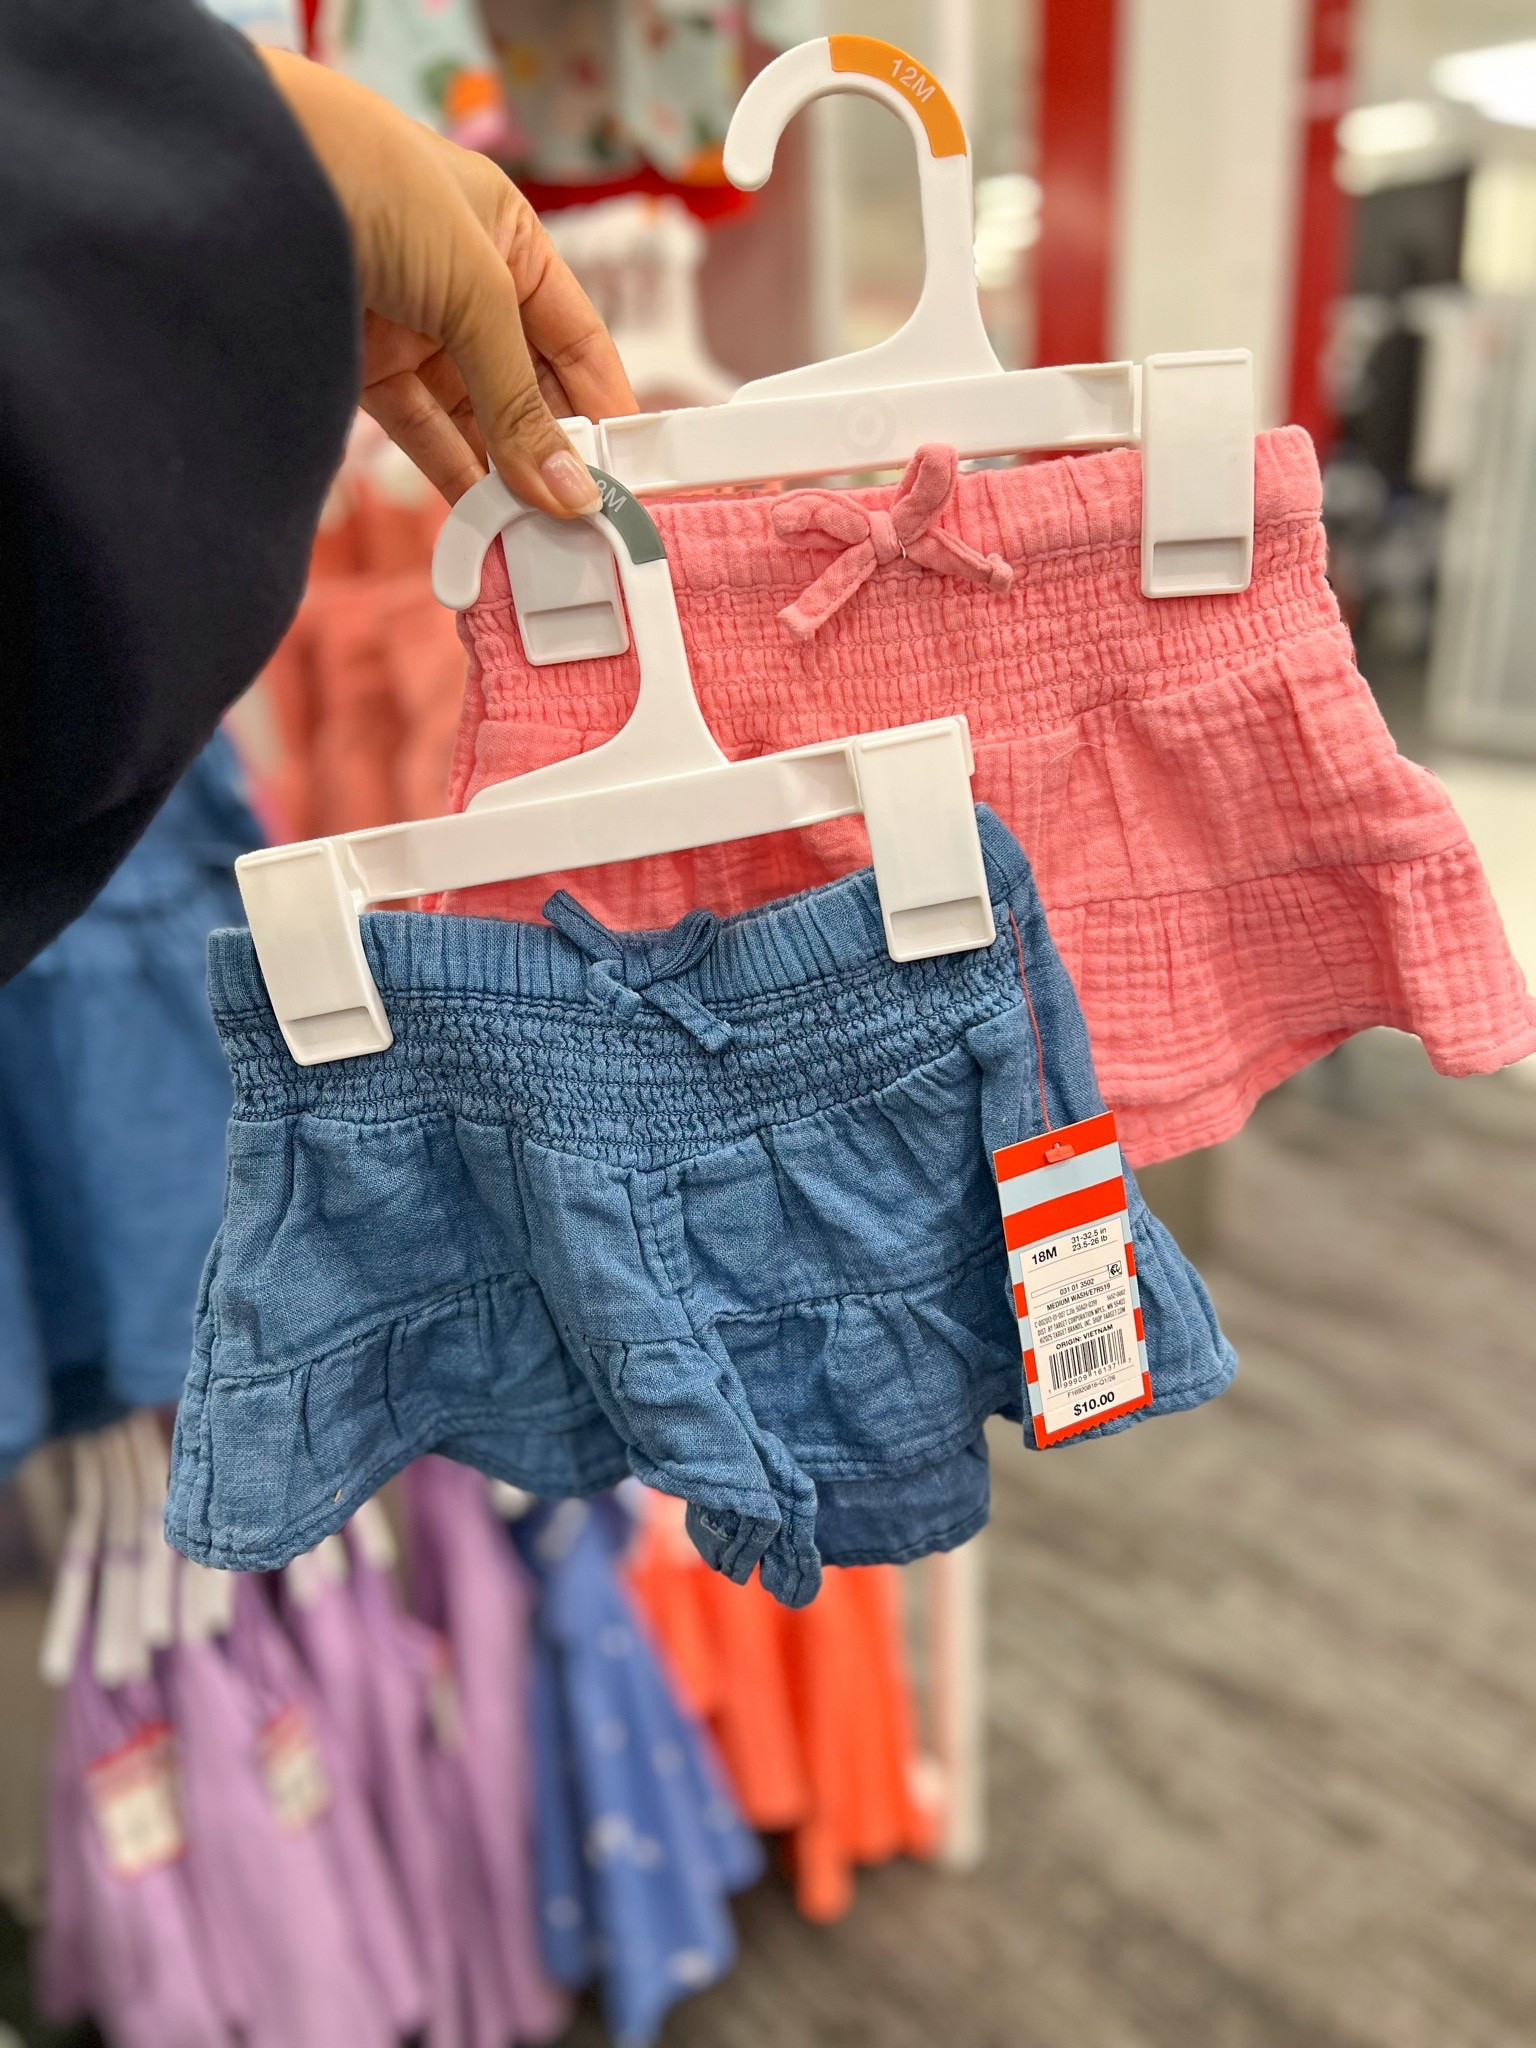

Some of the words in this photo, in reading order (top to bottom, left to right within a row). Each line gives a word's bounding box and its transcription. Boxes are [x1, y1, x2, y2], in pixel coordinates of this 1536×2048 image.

[891, 59, 937, 104] 12M
[596, 479, 628, 513] 8M
[1071, 1229, 1098, 1244] 31-32.5
[1100, 1226, 1107, 1234] in
[1072, 1237, 1099, 1252] 23.5-26
[1101, 1234, 1108, 1242] lb
[1032, 1246, 1058, 1265] 18M
[1060, 1287, 1070, 1296] 031
[1080, 1278, 1094, 1288] 3502
[1047, 1298, 1070, 1311] MEDIUM
[1054, 1320, 1067, 1330] TARGET
[1068, 1310, 1094, 1324] CORPORATION
[1053, 1328, 1067, 1339] TARGET
[1056, 1336, 1082, 1350] ORIGIN:
[1083, 1324, 1113, 1340] VIETNAM
[1064, 1374, 1088, 1388] 99909
[1094, 1363, 1116, 1376] 16137
[1073, 1391, 1115, 1417] $10.00
